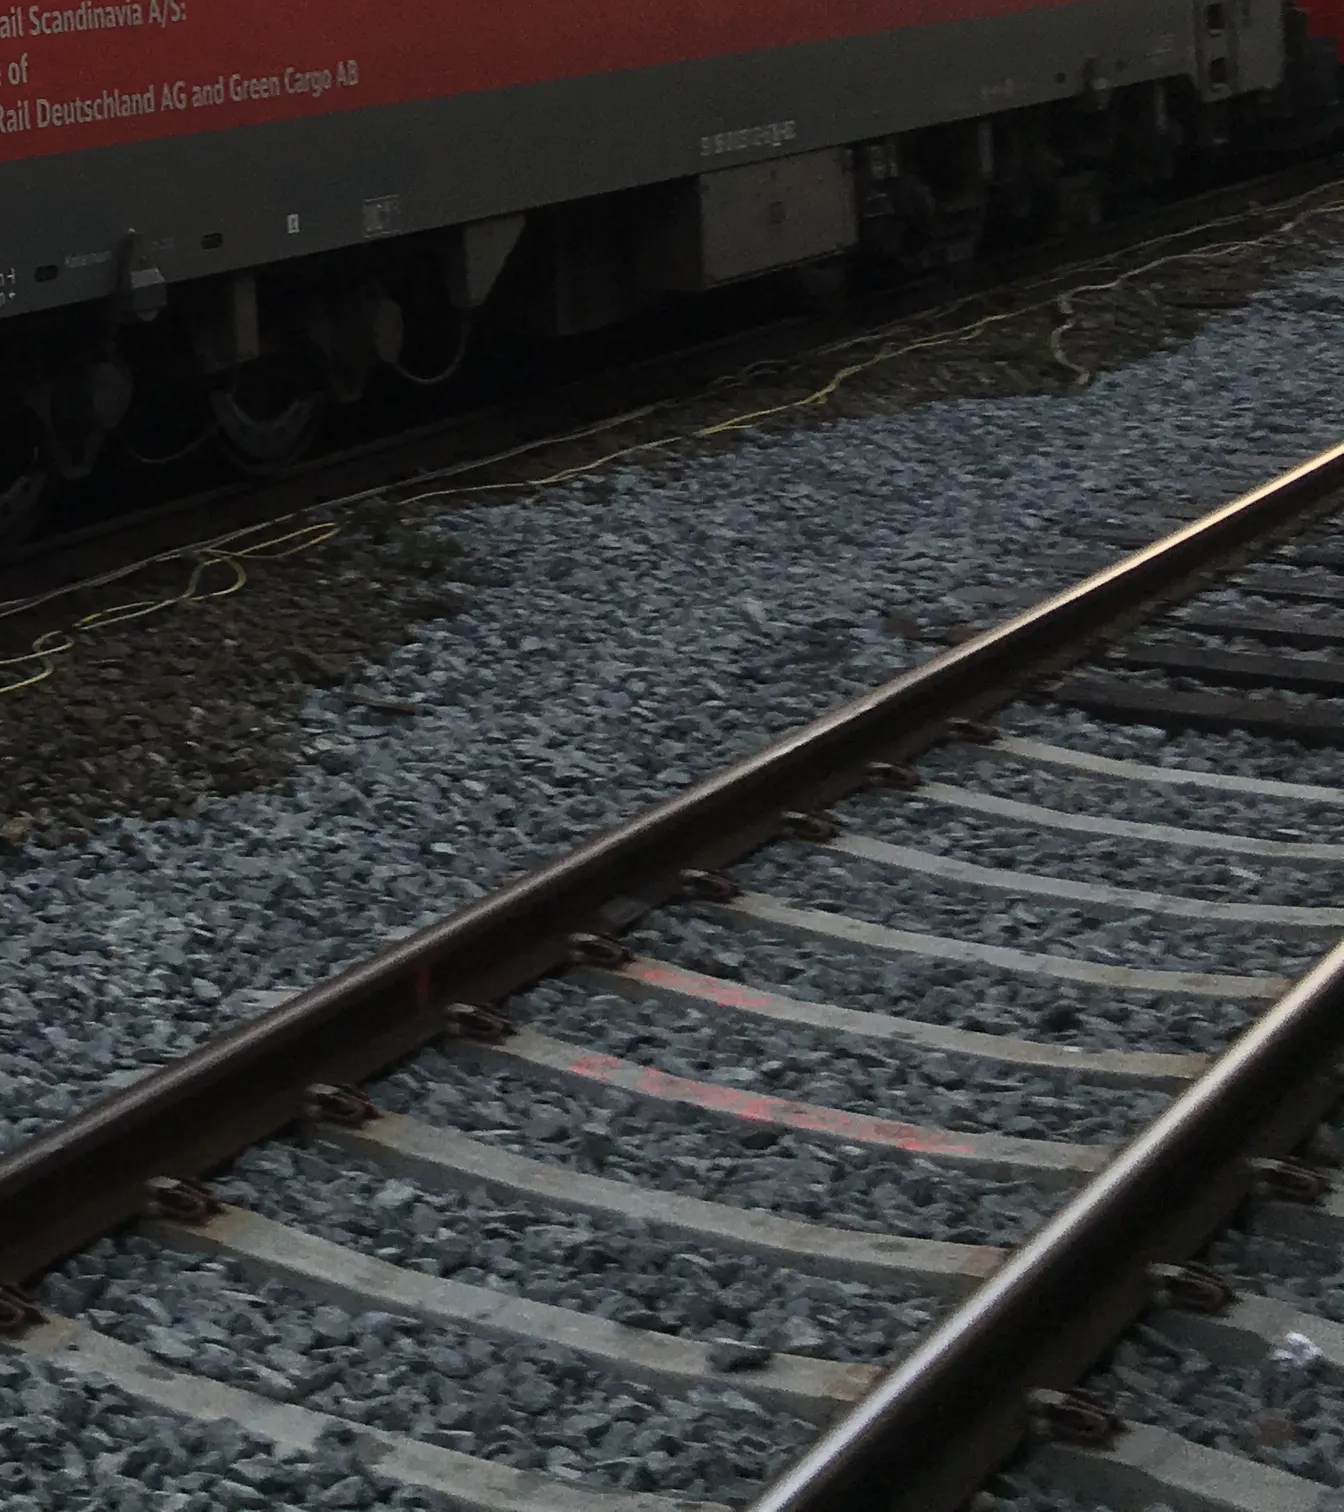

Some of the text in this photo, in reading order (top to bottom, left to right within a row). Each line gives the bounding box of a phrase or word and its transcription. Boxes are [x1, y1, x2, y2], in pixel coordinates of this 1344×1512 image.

[7, 52, 29, 85] of
[36, 84, 156, 128] Deutschland
[160, 80, 188, 112] AG
[191, 75, 225, 107] and
[228, 73, 280, 102] Green
[283, 66, 332, 98] Cargo
[335, 59, 359, 86] AB
